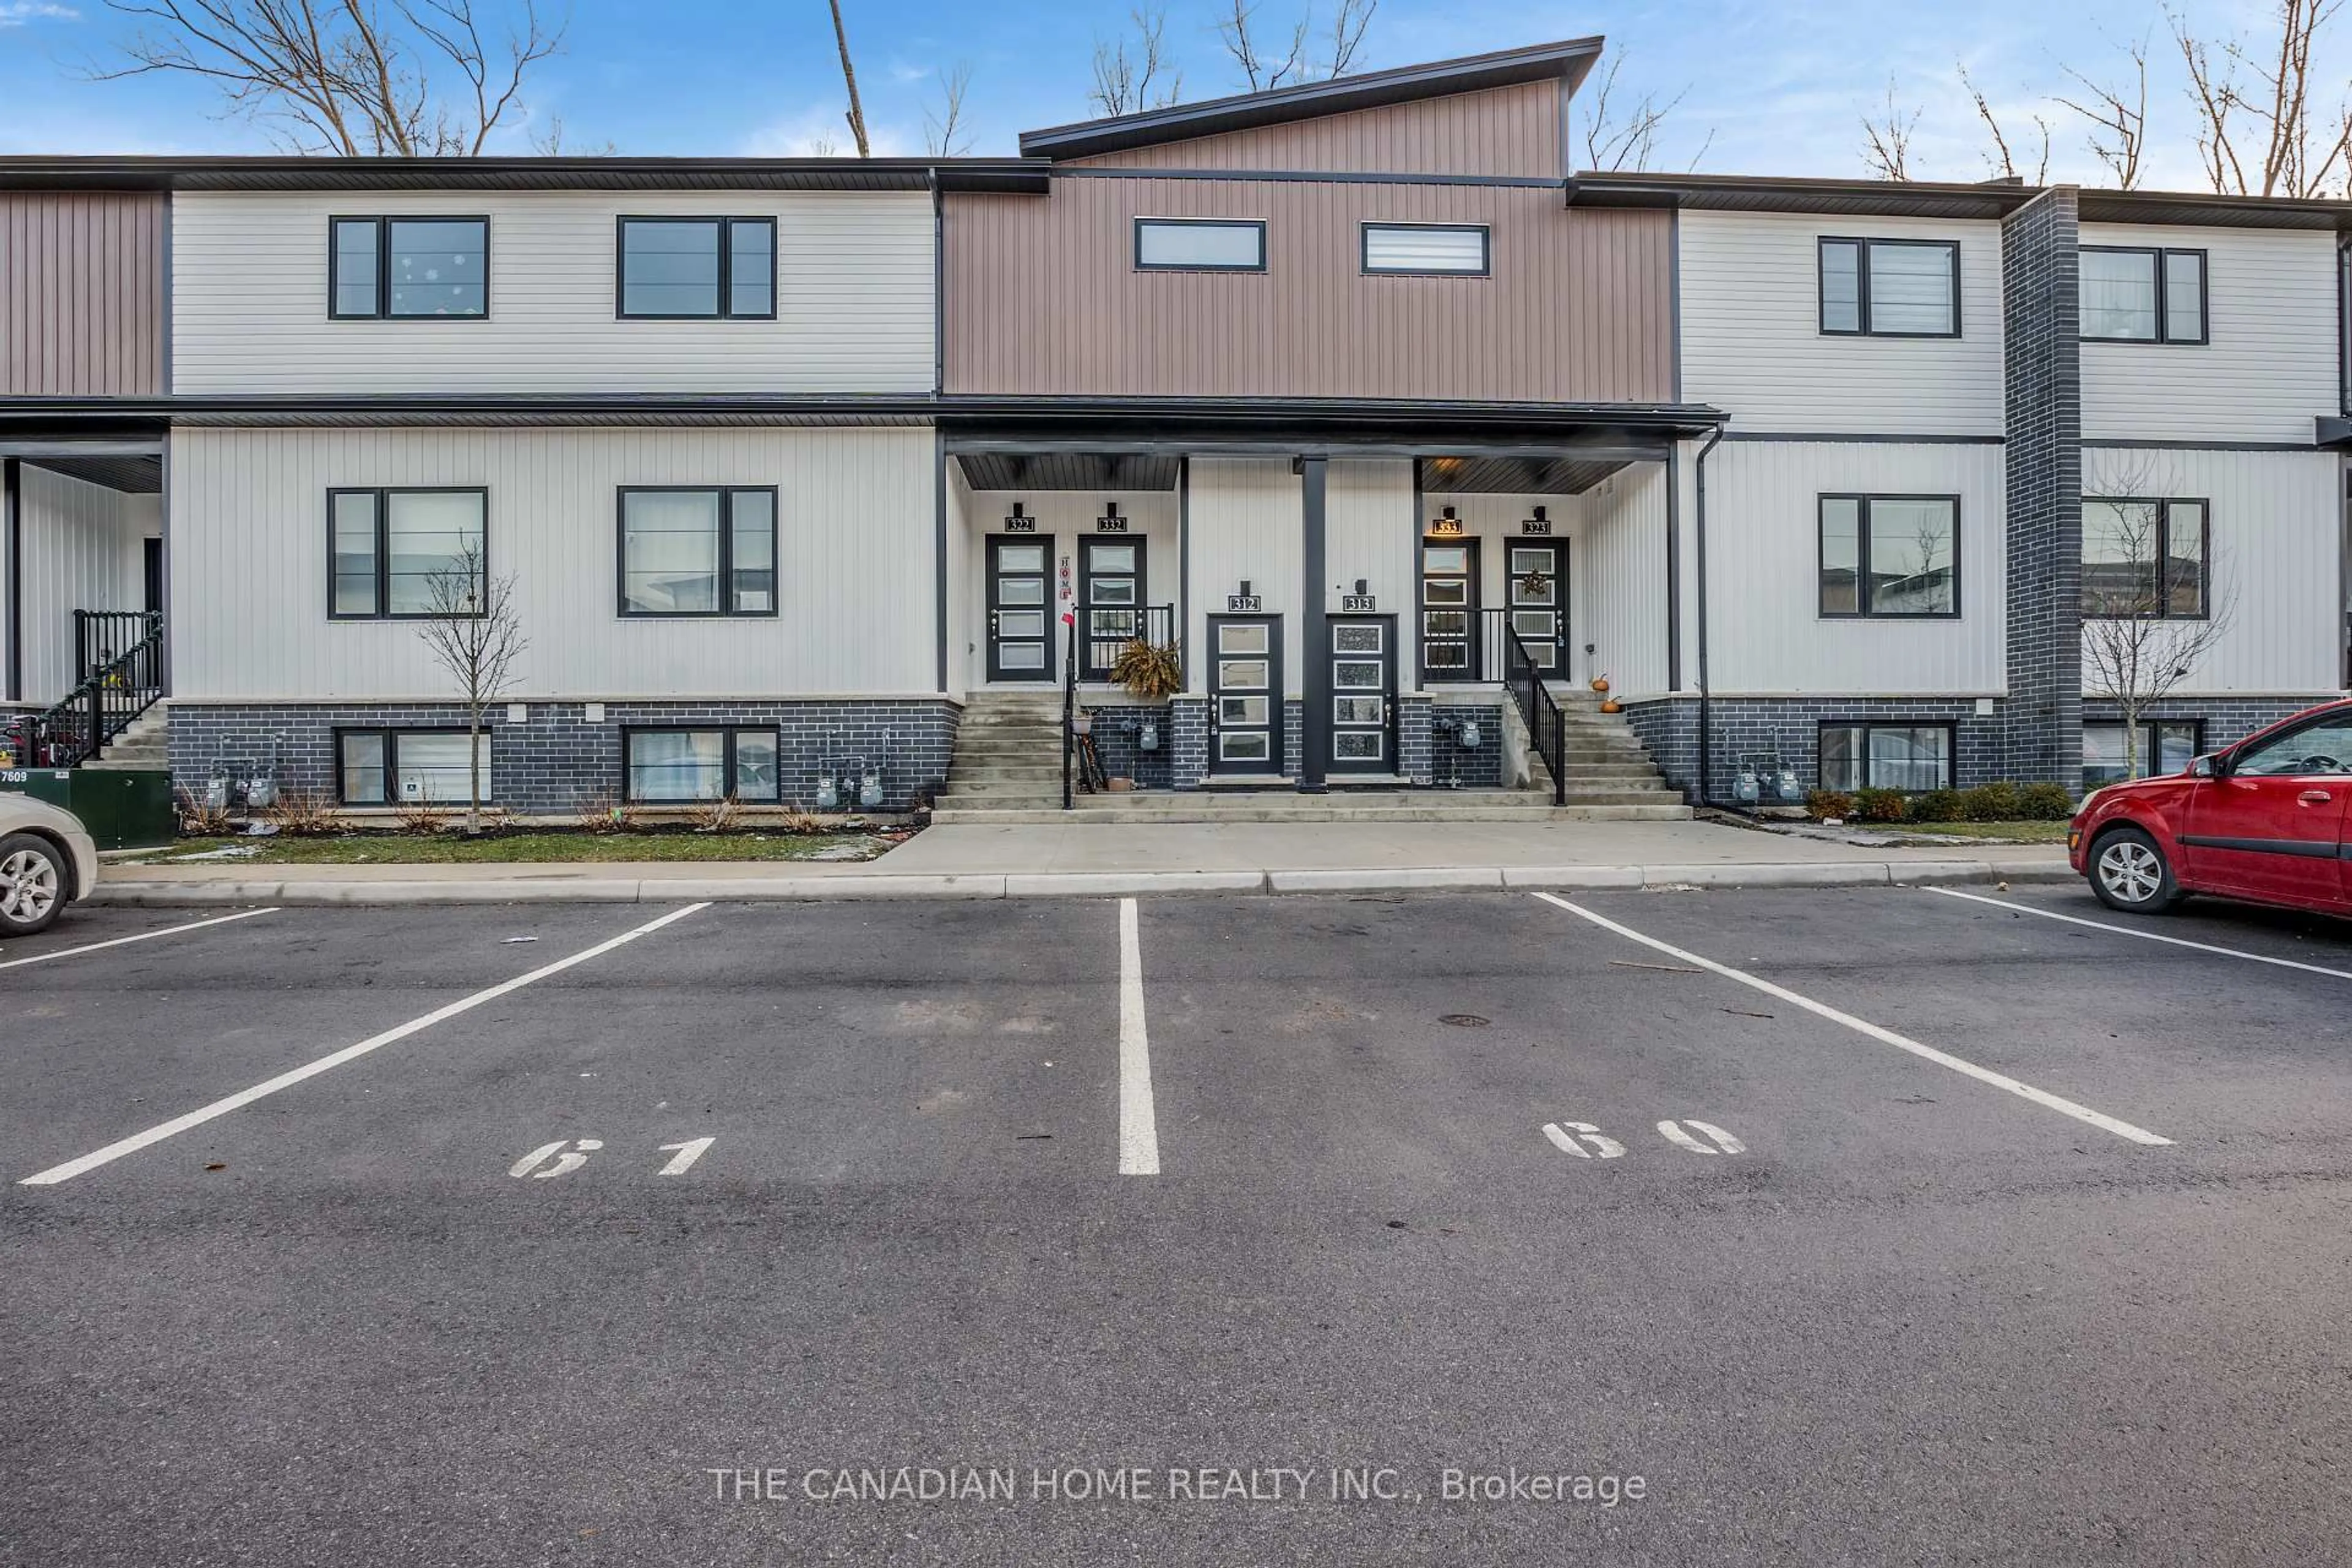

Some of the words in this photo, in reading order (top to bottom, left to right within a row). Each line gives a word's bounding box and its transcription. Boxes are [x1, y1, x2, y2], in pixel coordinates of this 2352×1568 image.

[1011, 520, 1030, 530] 322
[1103, 520, 1121, 530] 332
[1438, 522, 1458, 532] 333
[1527, 522, 1547, 532] 323
[1061, 559, 1069, 599] HOME
[1234, 598, 1256, 609] 312
[1349, 598, 1370, 609] 313
[1, 771, 27, 782] 7609
[1542, 1120, 1746, 1158] 60
[508, 1137, 716, 1178] 61
